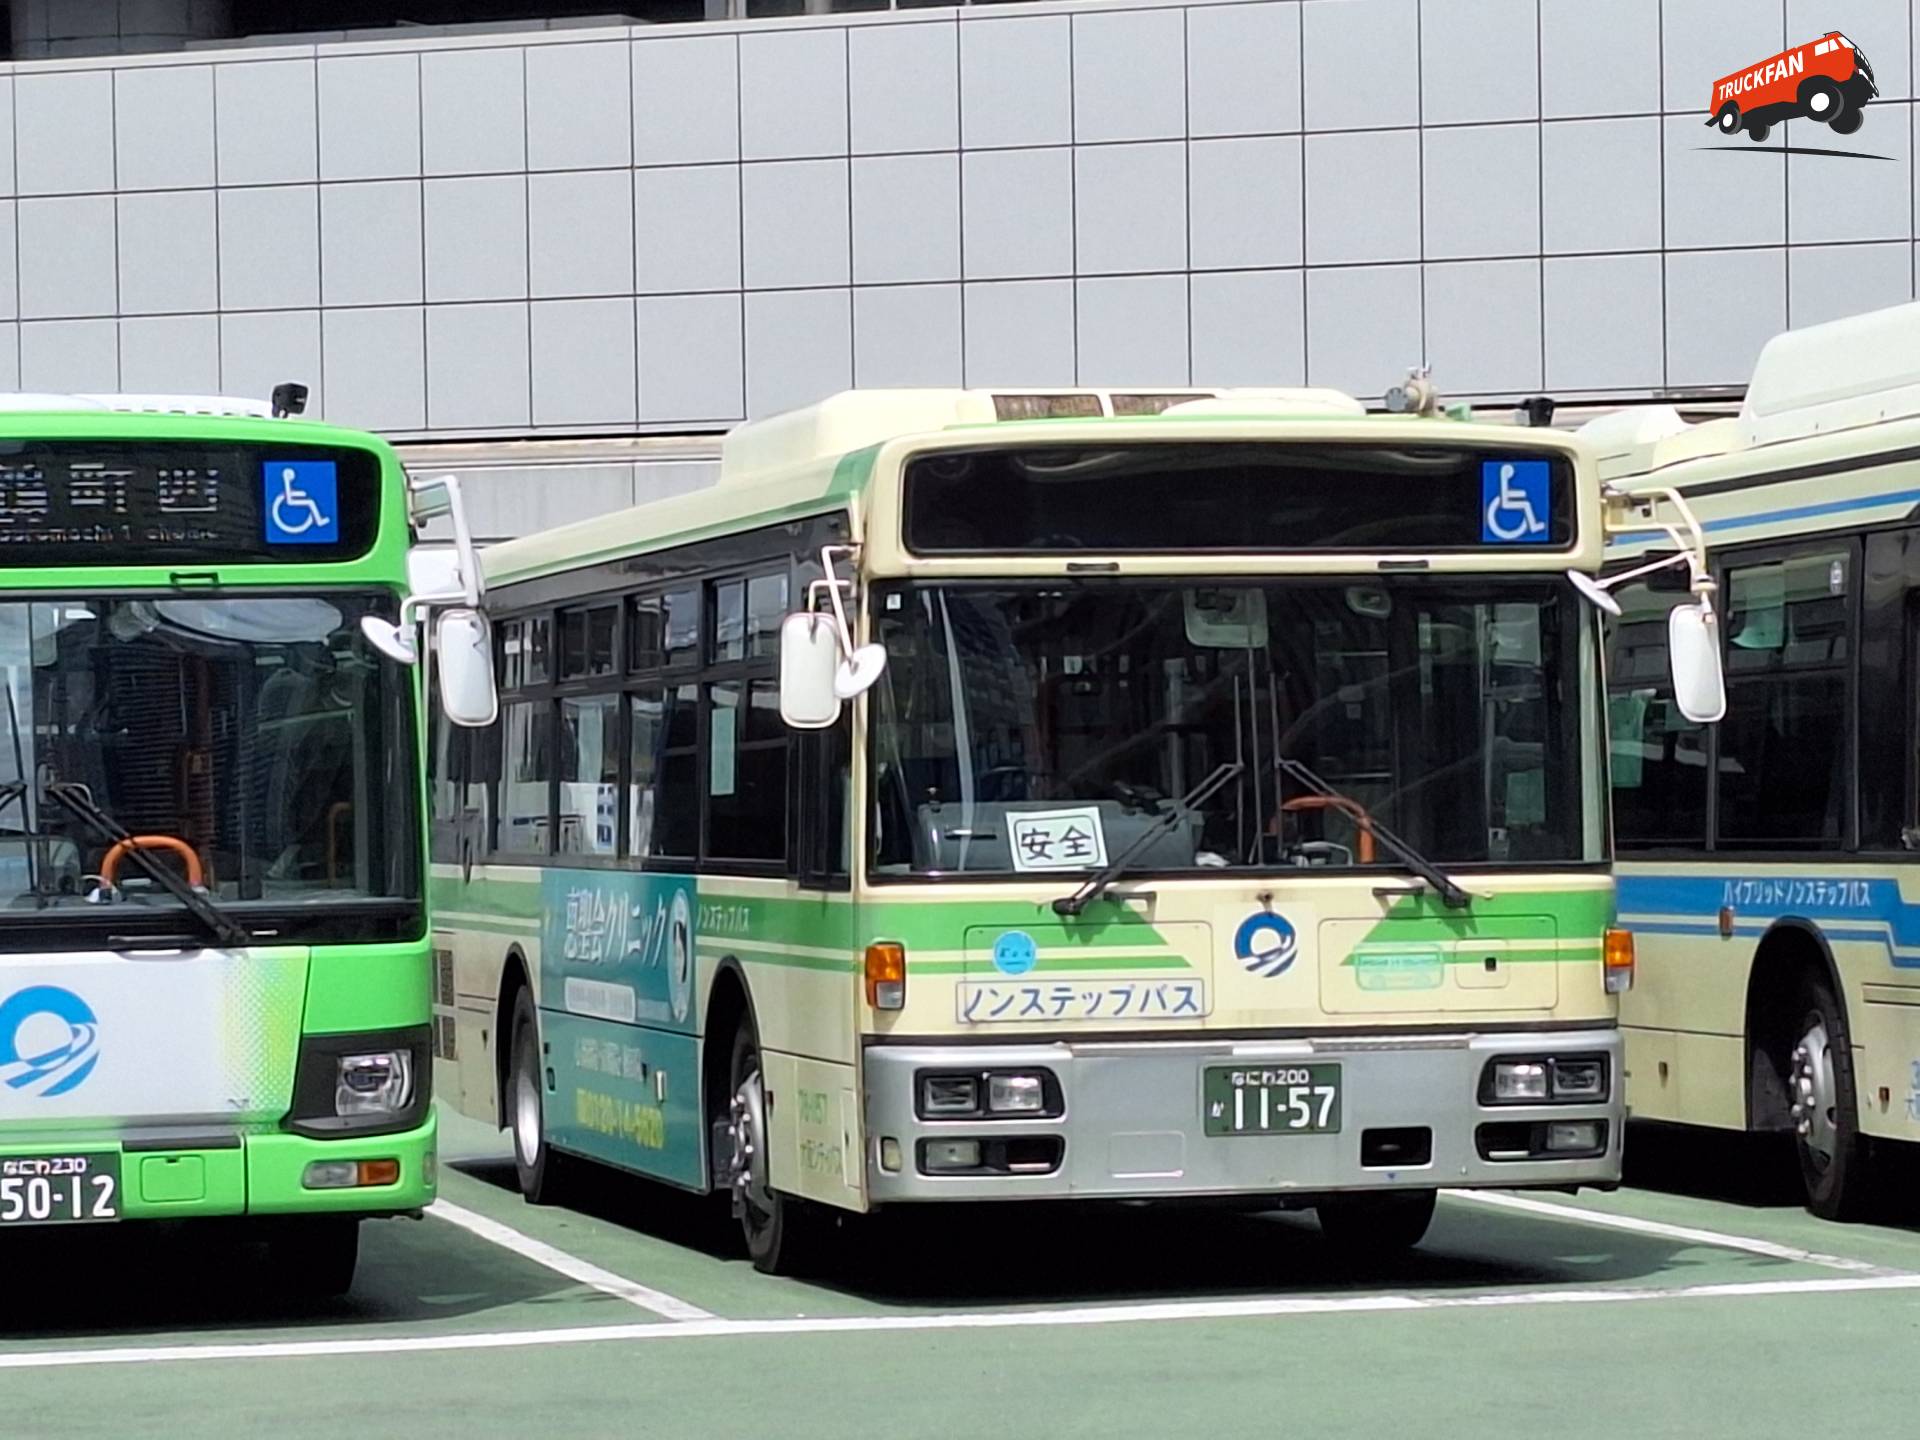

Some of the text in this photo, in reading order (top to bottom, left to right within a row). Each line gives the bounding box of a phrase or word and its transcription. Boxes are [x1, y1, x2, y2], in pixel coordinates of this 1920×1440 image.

[1021, 825, 1092, 860] 安全
[1723, 879, 1872, 907] ハイブリッドノンステップバス
[964, 985, 1198, 1018] ノンステップバス
[1234, 1085, 1336, 1130] 11-57
[0, 1174, 116, 1220] 50-12
